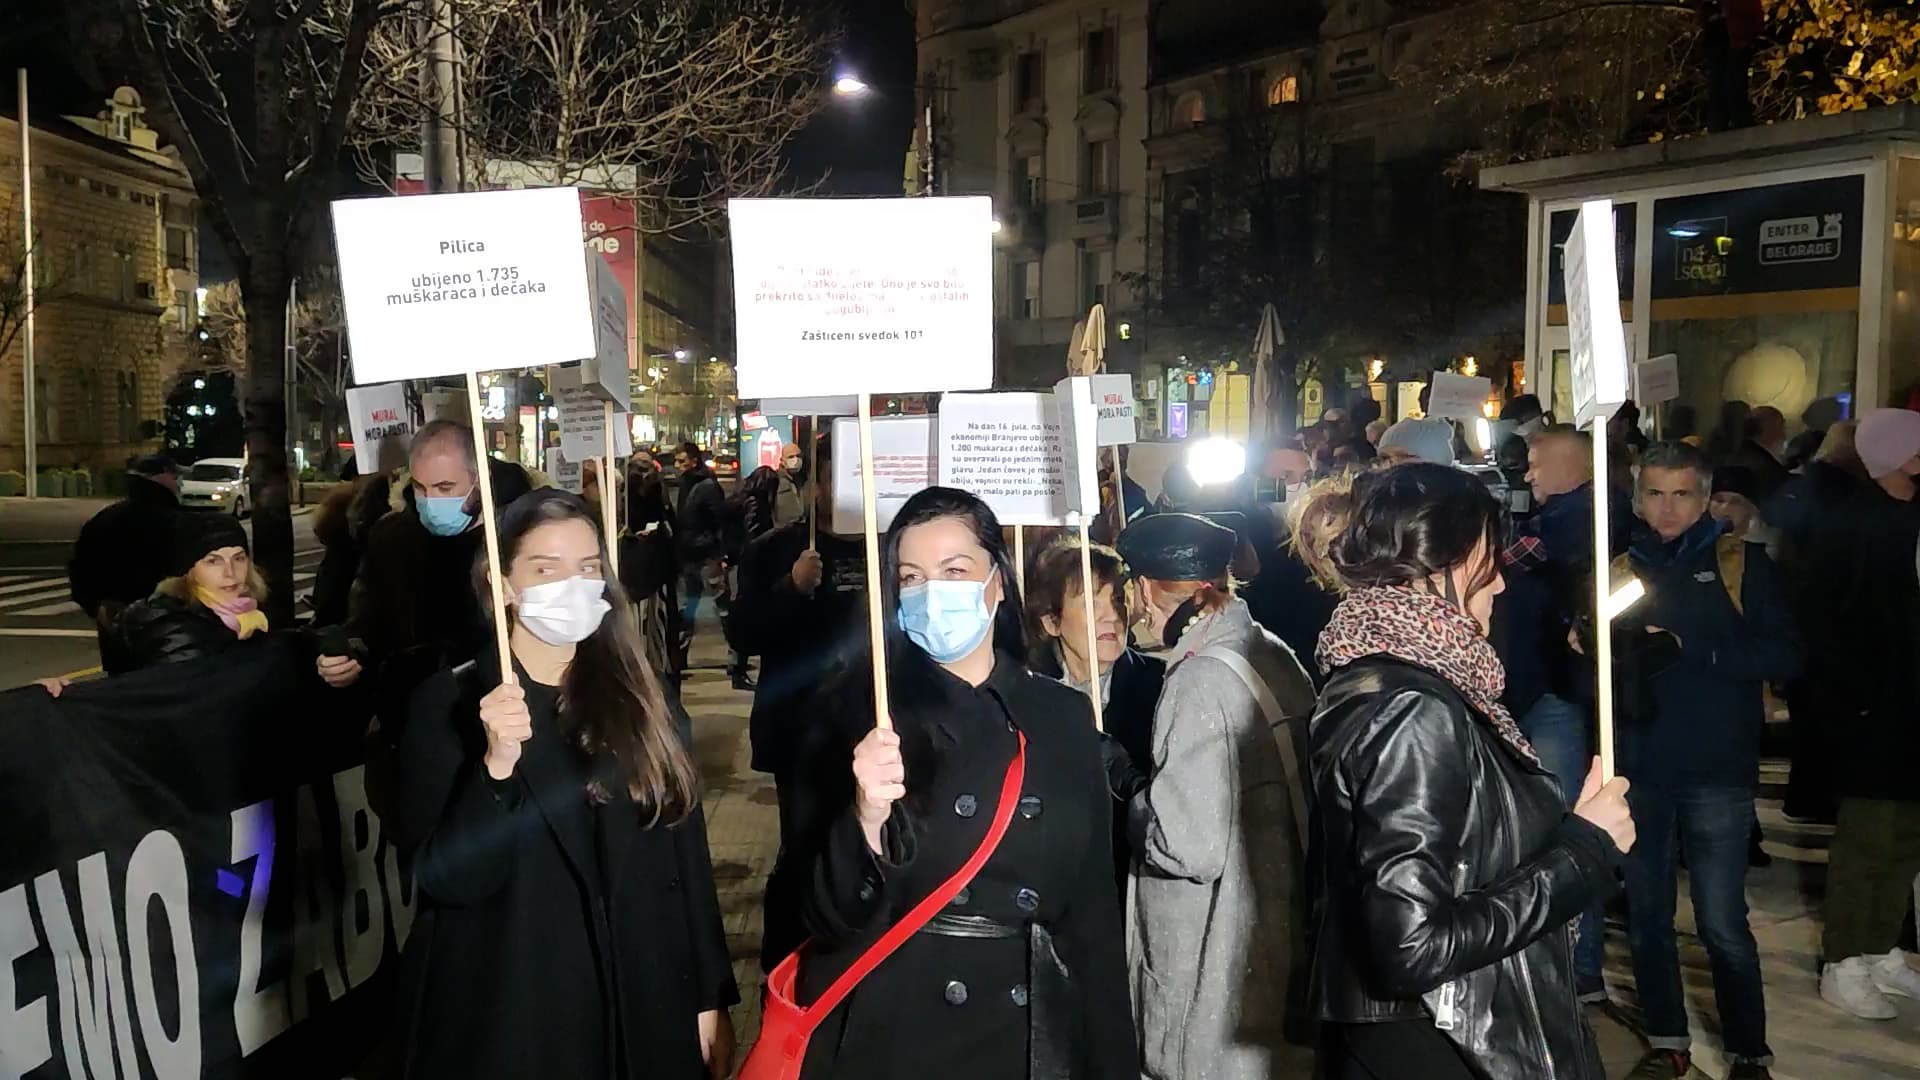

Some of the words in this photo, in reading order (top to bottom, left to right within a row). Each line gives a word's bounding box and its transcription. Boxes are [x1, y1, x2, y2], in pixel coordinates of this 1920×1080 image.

[590, 220, 605, 232] do
[1767, 223, 1809, 238] ENTER
[439, 240, 485, 255] Pilica
[1766, 243, 1833, 259] BELGRADE
[411, 273, 471, 289] ubijeno
[477, 267, 519, 282] 1.735
[386, 288, 477, 305] muškaraca
[490, 280, 546, 296] dečaka
[859, 330, 900, 340] svedok
[371, 409, 398, 422] MURAL
[1098, 408, 1117, 419] MORA
[968, 422, 979, 430] Na
[981, 422, 996, 430] dan
[951, 433, 990, 442] ekonomiji
[992, 433, 1027, 442] Branjevo
[1030, 434, 1059, 443] ubijeno
[951, 443, 972, 452] 1.200
[1014, 455, 1041, 465] jednim
[984, 488, 1004, 496] malo
